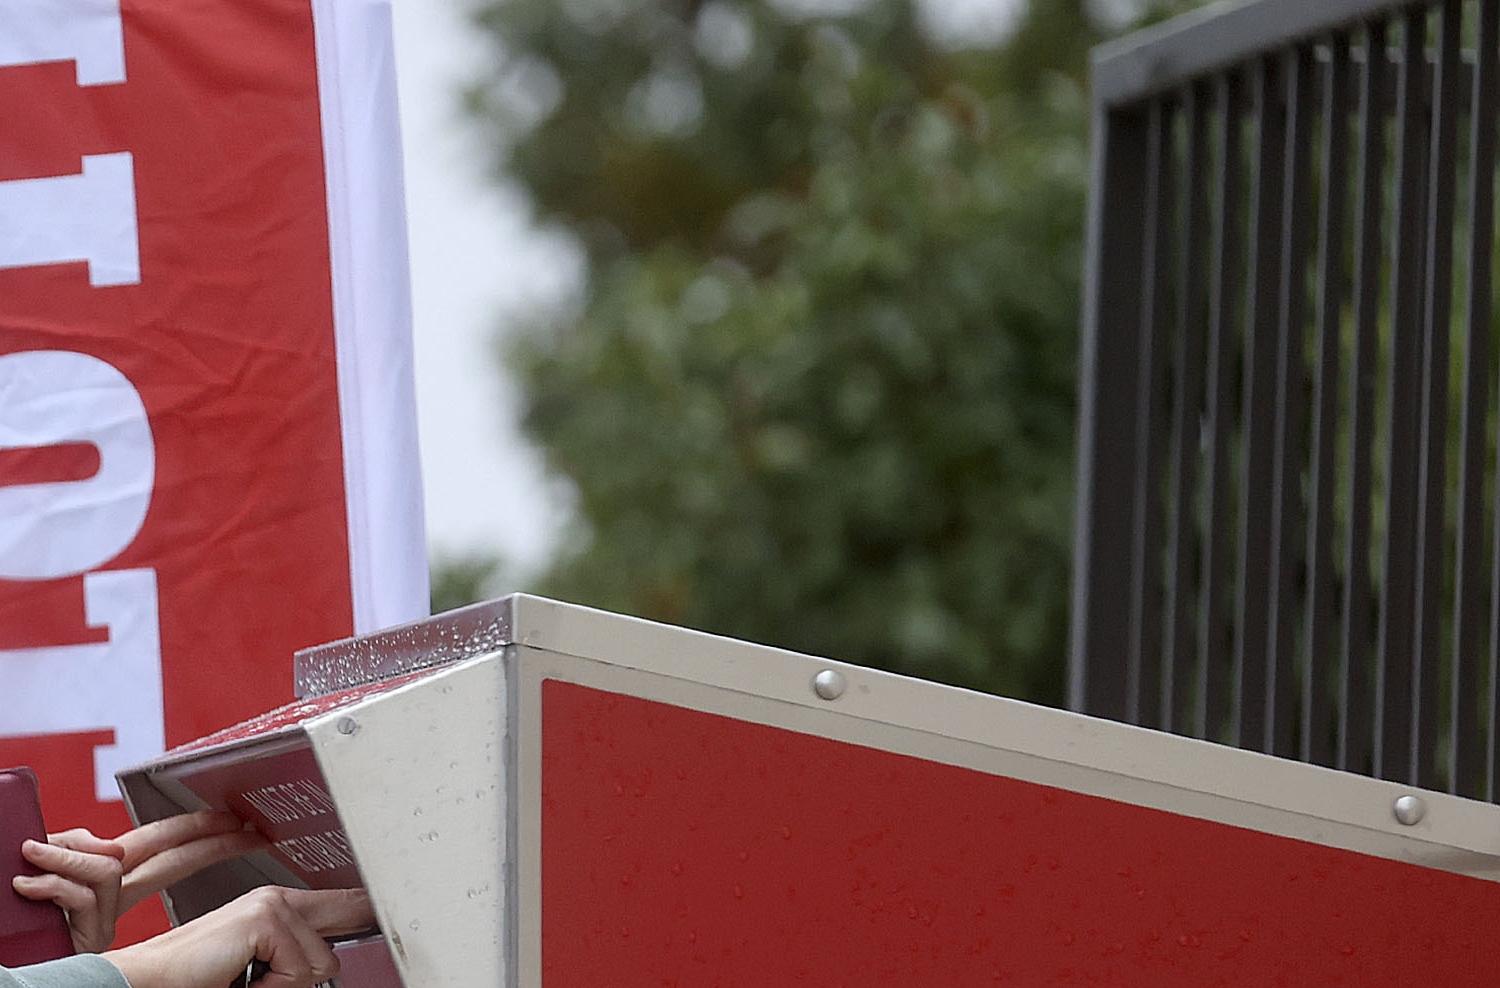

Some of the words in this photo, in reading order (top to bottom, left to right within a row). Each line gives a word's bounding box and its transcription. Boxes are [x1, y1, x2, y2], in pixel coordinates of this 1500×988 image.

[242, 787, 306, 824] MUST
[278, 782, 327, 817] BE
[275, 834, 353, 872] RETURN
